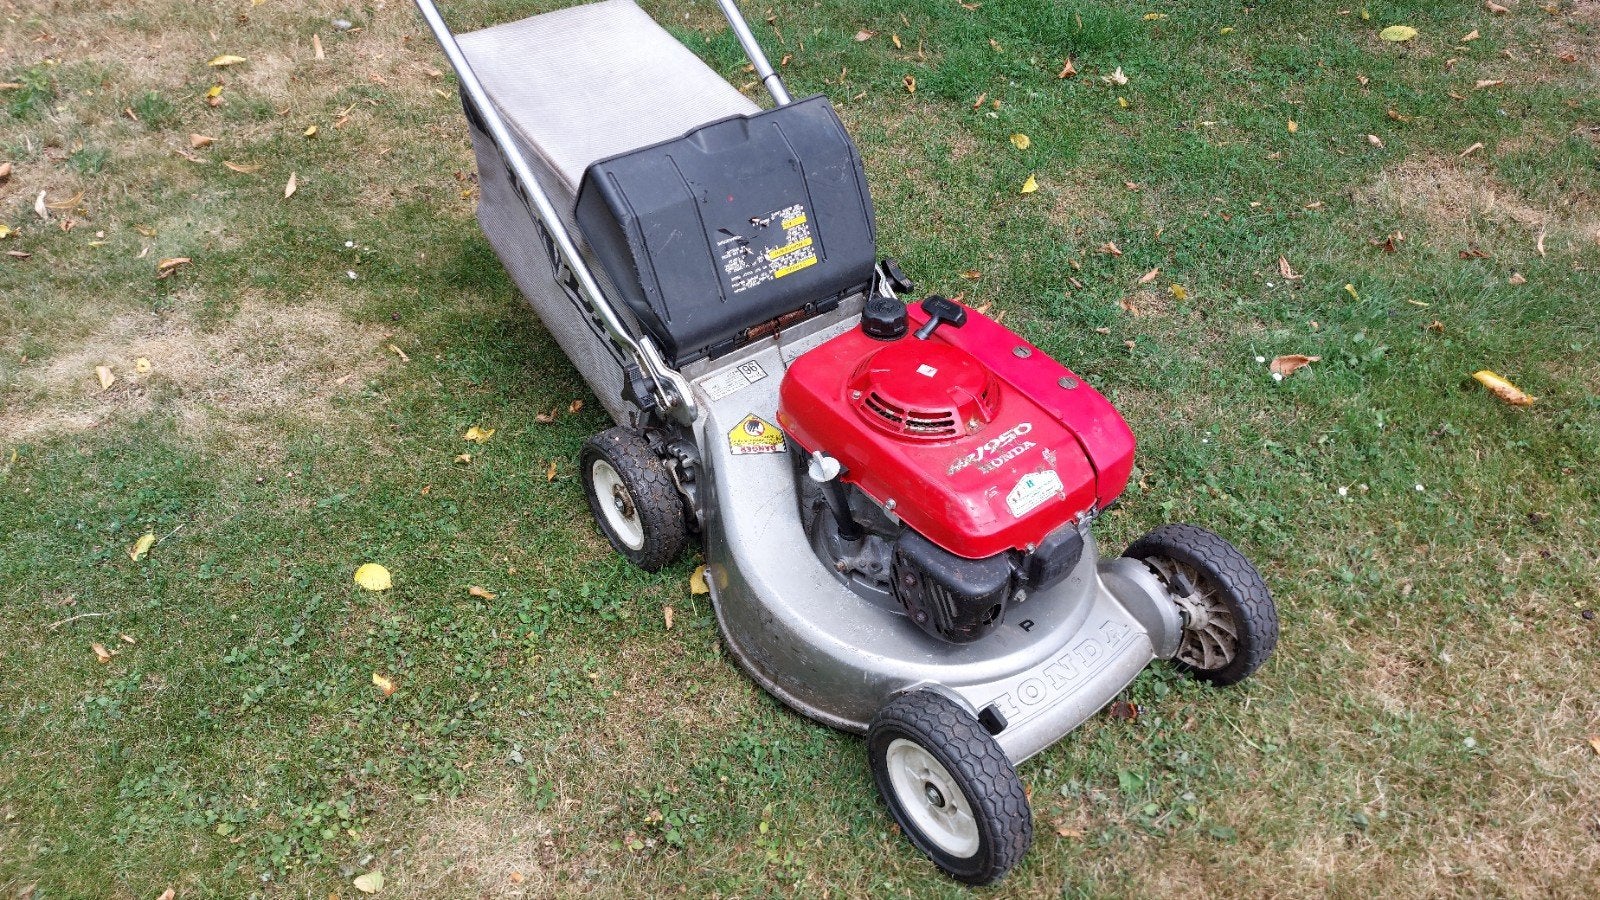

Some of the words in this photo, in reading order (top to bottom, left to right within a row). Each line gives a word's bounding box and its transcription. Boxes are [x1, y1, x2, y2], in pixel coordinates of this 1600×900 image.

[742, 362, 758, 375] 96
[740, 444, 777, 454] DANGER
[978, 441, 1037, 475] HONDA
[1018, 619, 1035, 632] P
